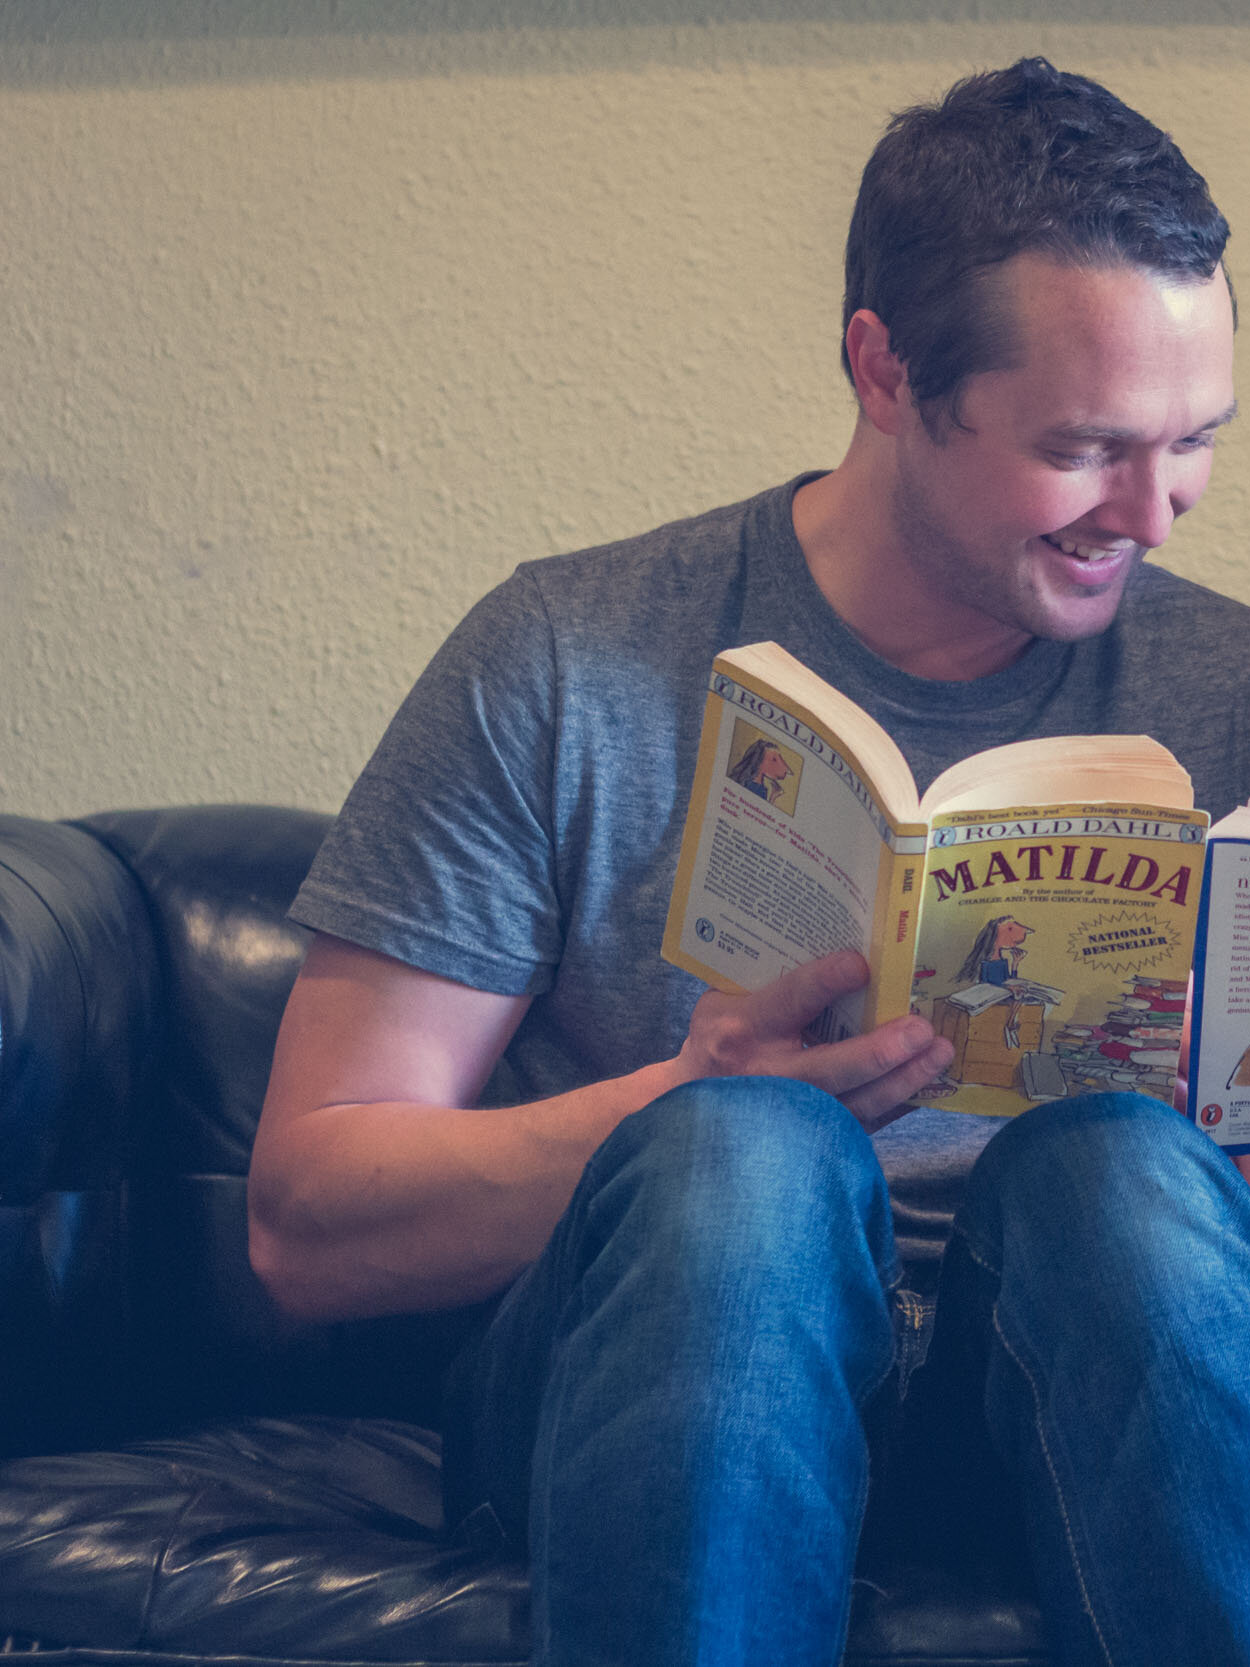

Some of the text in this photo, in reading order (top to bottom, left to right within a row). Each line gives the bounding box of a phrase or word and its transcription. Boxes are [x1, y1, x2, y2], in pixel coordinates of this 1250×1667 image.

[740, 691, 823, 754] ROALD
[988, 812, 1009, 820] best
[1014, 809, 1038, 817] book
[966, 818, 1172, 840] ROALD DAHL
[928, 845, 1192, 906] MATILDA
[958, 897, 1002, 906] CHARLIE
[1051, 896, 1110, 904] CHOCOLATE
[1112, 898, 1157, 907] FACTORY
[896, 911, 909, 943] Matilda
[1088, 926, 1155, 944] NATIONAL
[1082, 936, 1167, 956] BESTSELLER
